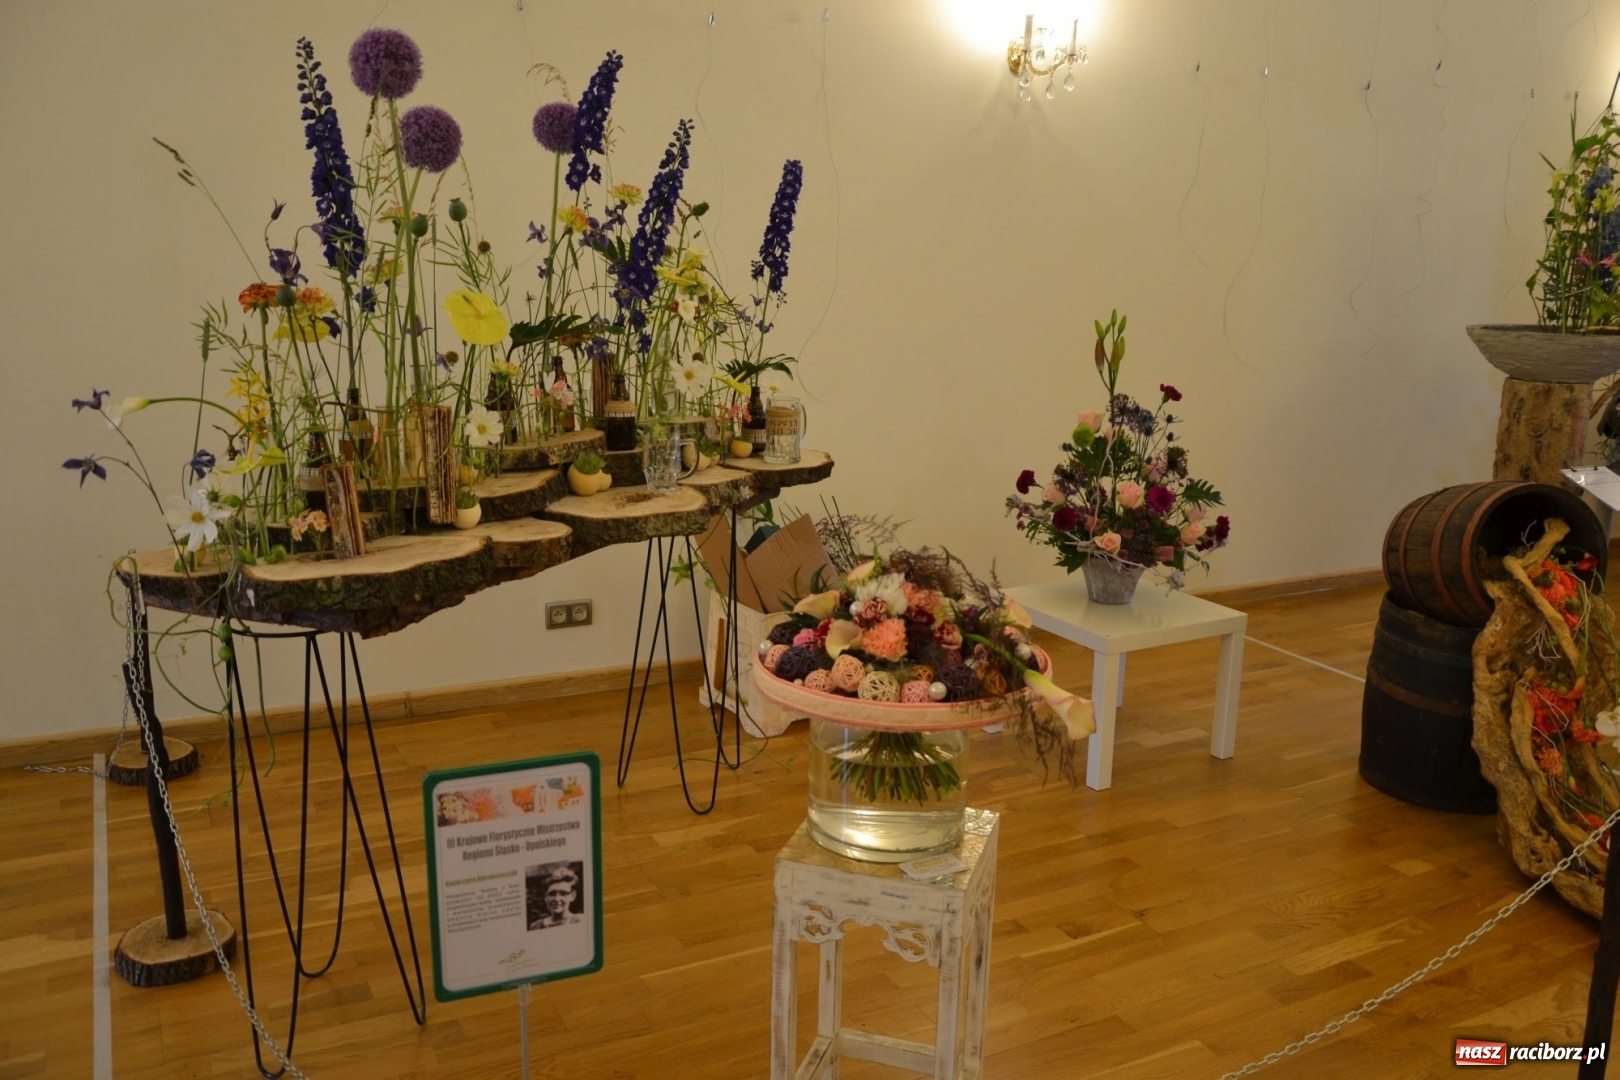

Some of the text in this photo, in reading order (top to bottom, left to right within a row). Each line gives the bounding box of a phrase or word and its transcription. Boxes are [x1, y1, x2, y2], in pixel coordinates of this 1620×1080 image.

[446, 820, 580, 849] III Krajowe Florystyczne Mistrzostwa
[462, 848, 494, 862] Regionu
[495, 842, 520, 857] Śląsko
[525, 837, 566, 852] Opolskiego
